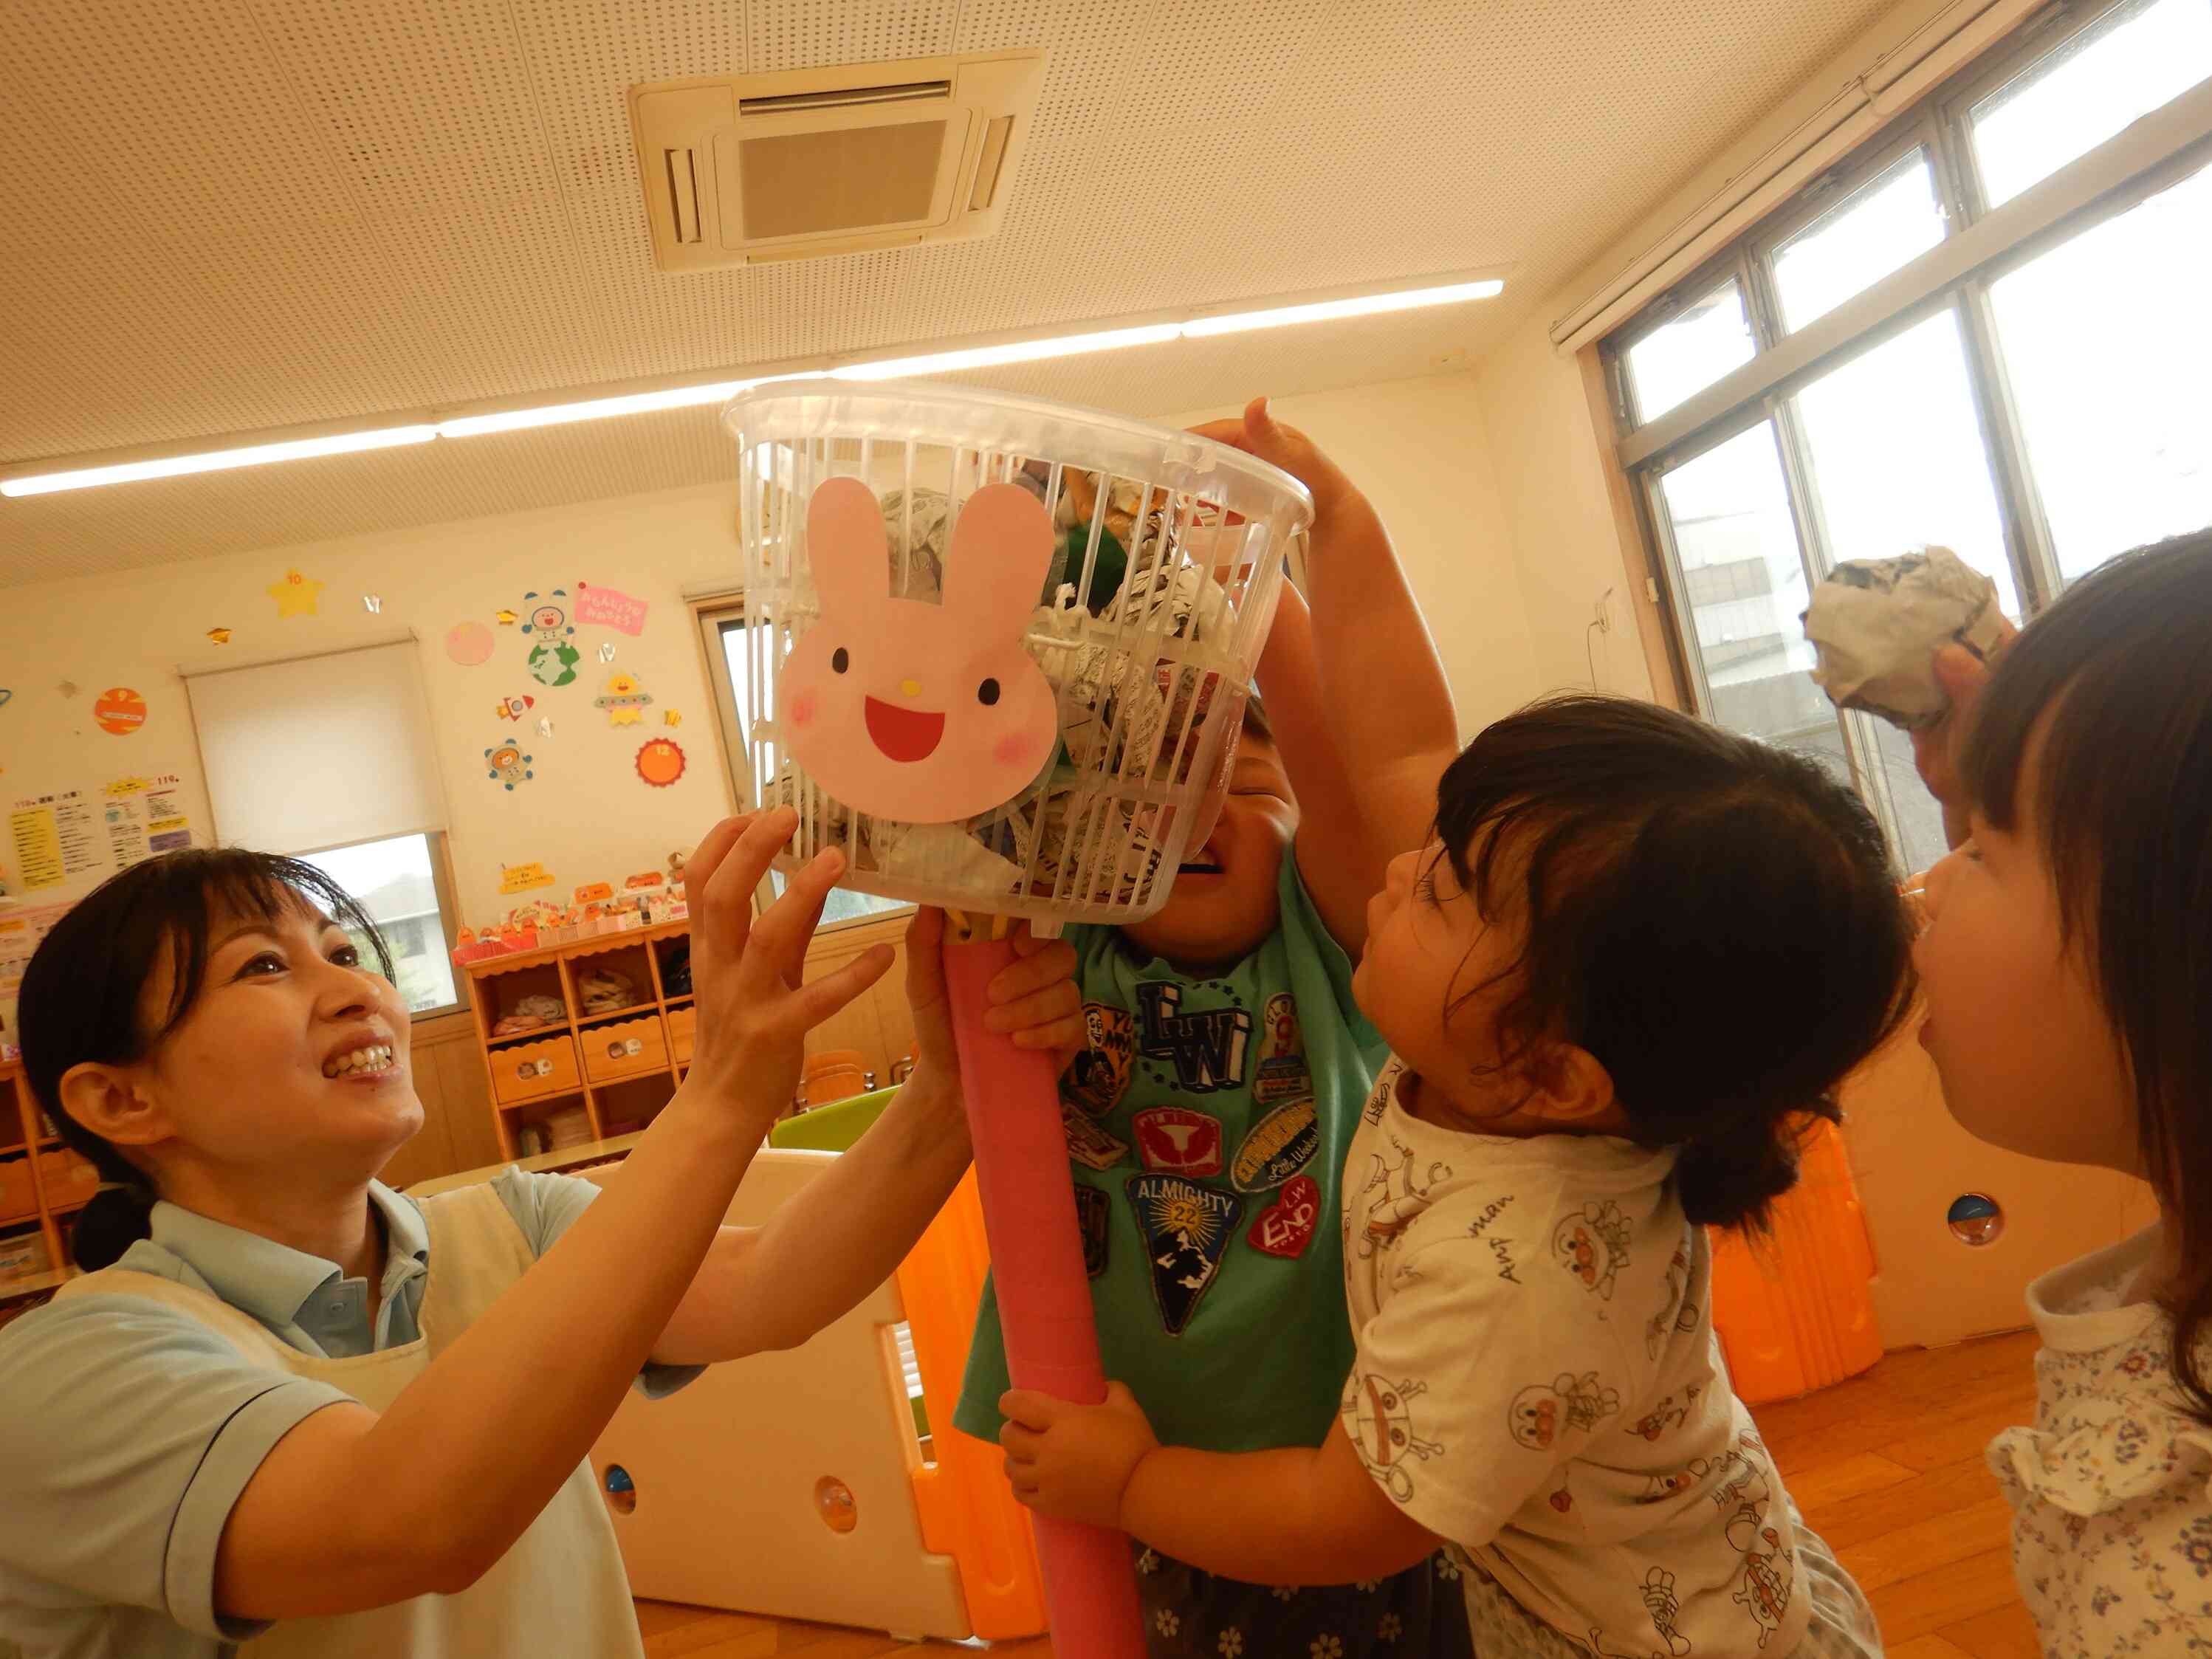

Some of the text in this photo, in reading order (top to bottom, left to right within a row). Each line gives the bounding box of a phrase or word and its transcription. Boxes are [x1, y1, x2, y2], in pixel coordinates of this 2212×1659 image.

[1137, 1179, 1233, 1217] ALMIGHTY
[1174, 1206, 1196, 1224] 22
[1263, 1203, 1313, 1247] END
